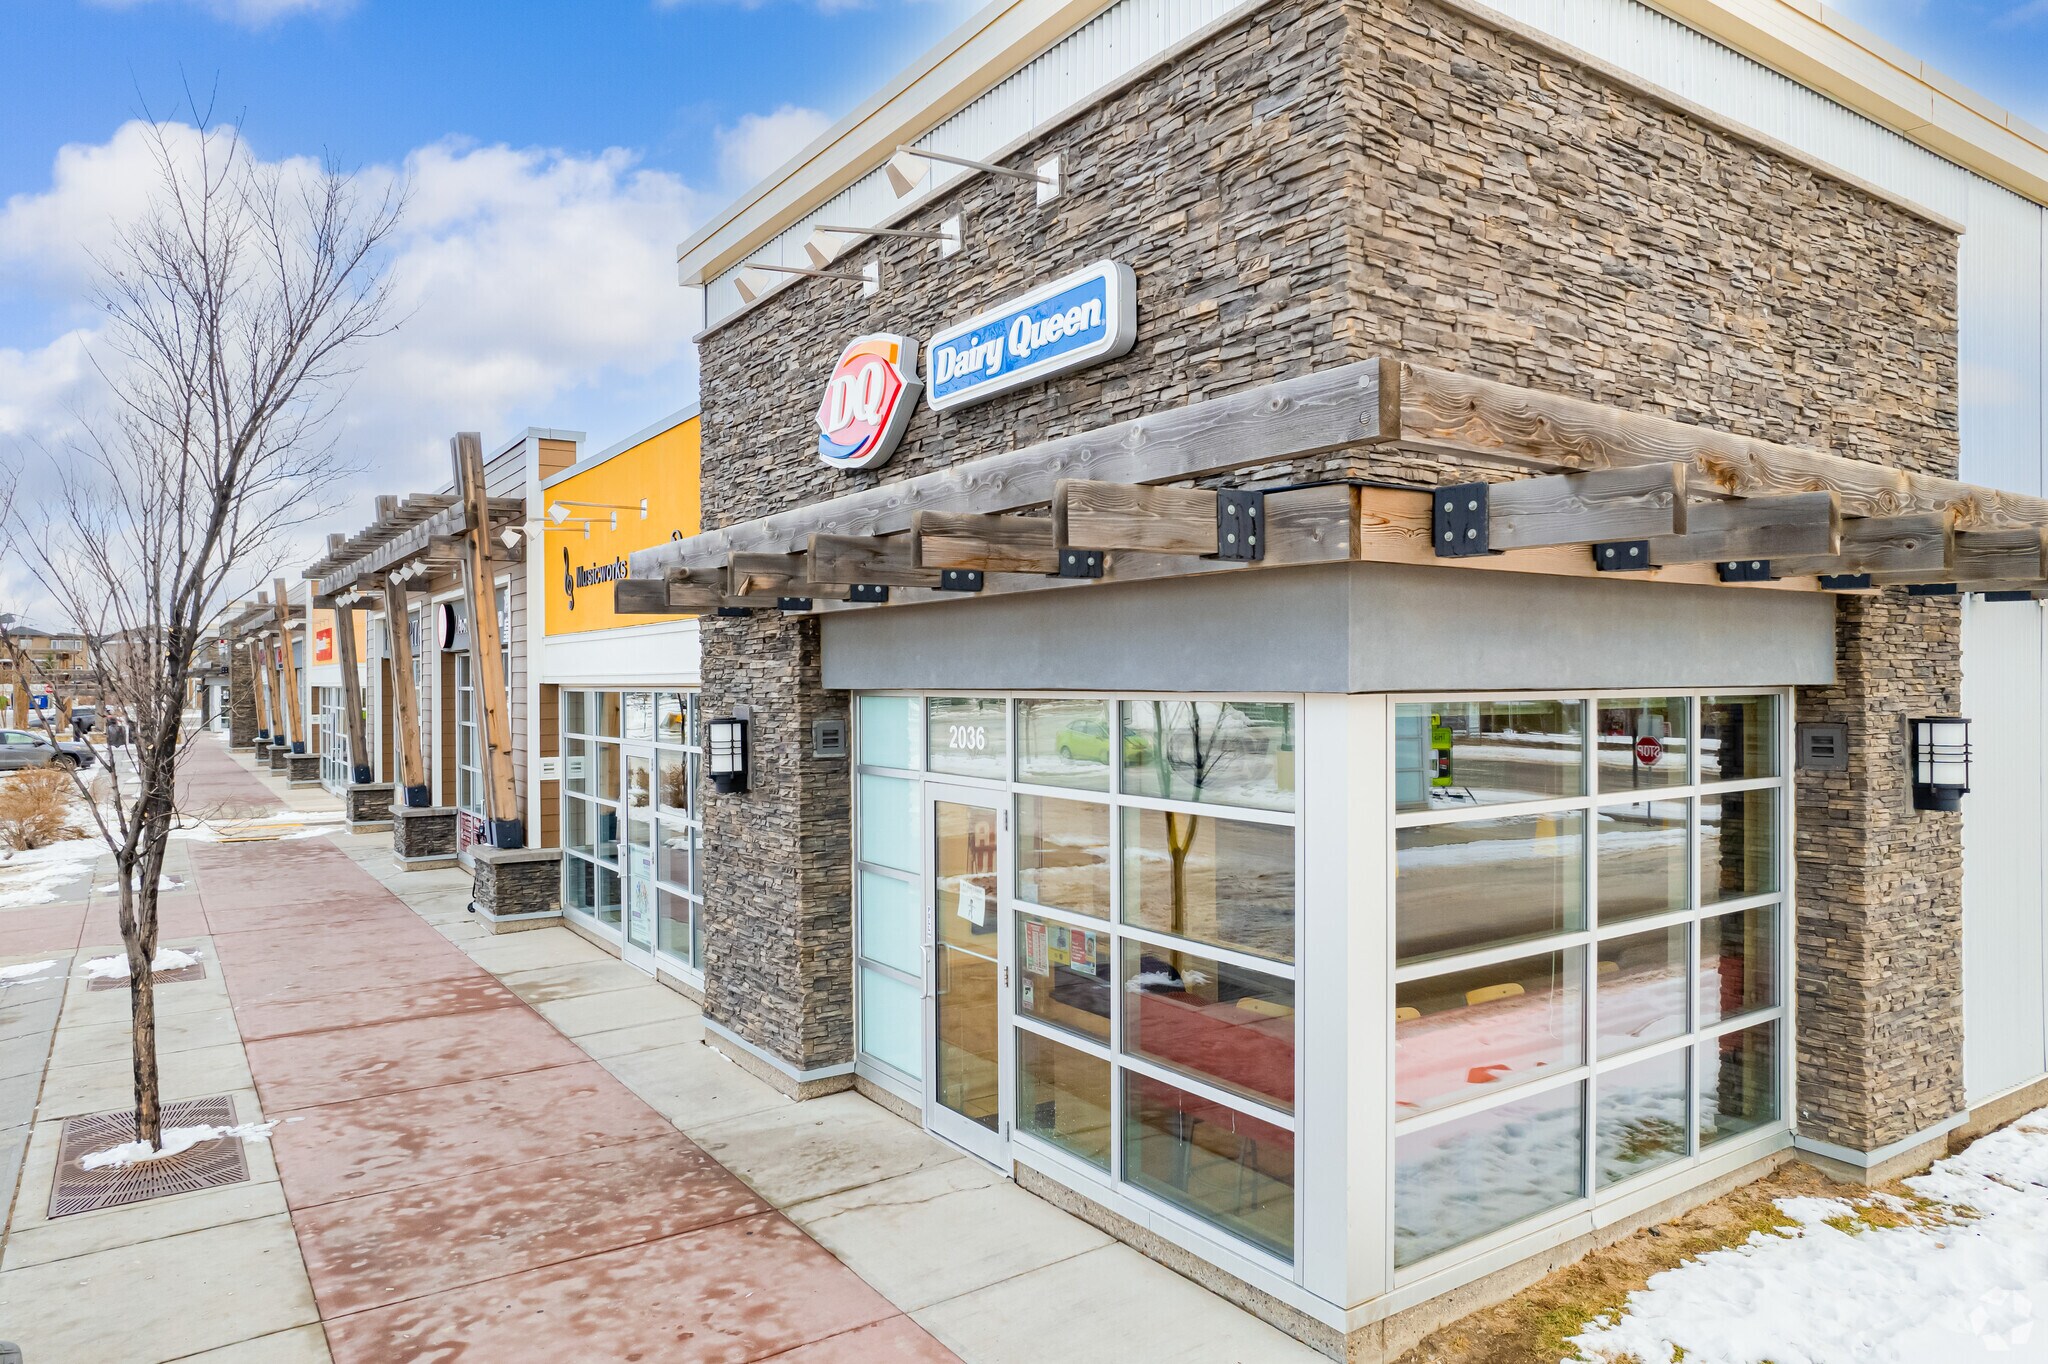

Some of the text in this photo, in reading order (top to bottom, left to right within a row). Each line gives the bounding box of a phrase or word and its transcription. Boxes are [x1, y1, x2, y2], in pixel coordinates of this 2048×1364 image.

[936, 298, 1102, 386] Dairy Queen
[830, 361, 884, 433] DQ
[576, 556, 627, 588] Musicworks
[950, 725, 986, 750] 2036
